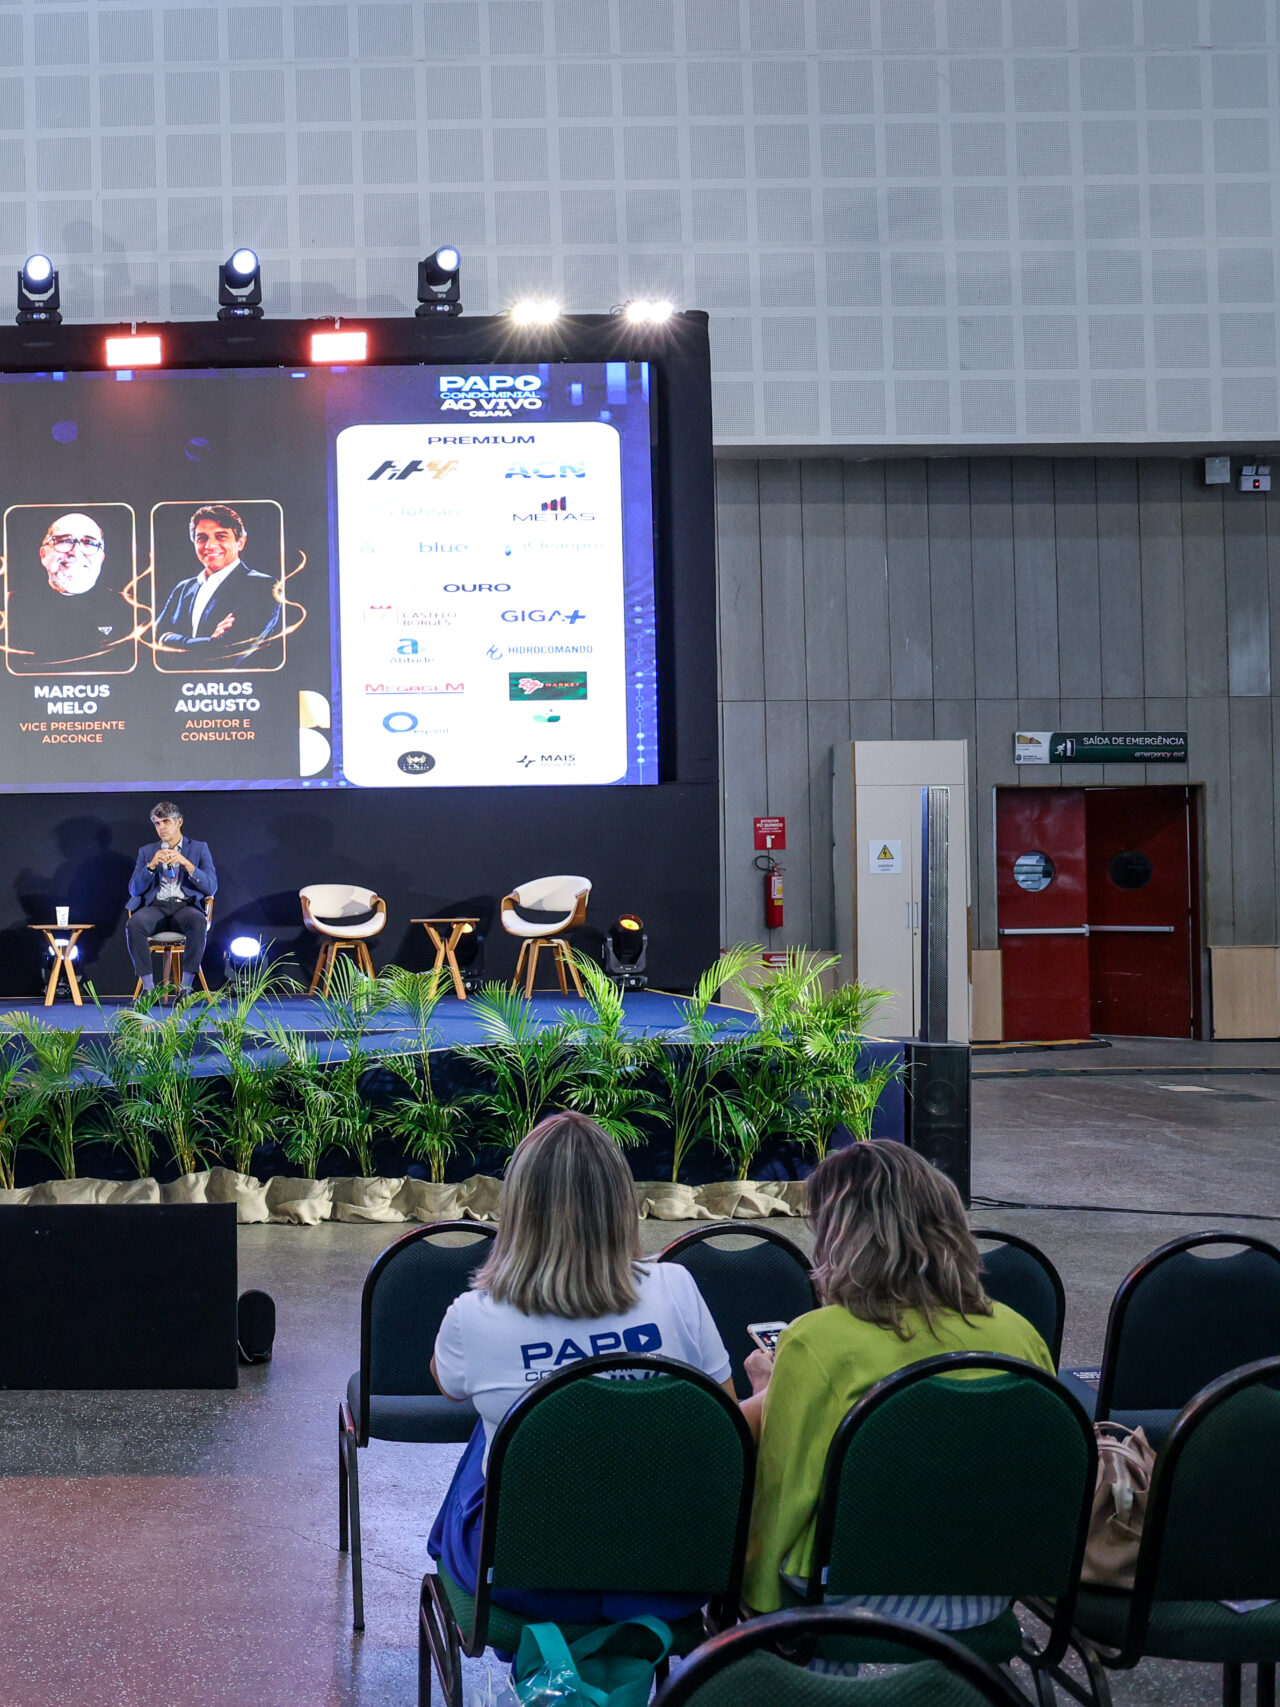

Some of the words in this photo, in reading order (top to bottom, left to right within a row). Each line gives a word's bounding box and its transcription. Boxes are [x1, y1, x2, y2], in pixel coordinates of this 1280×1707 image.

[439, 375, 542, 391] PAPO
[440, 399, 477, 410] AO
[479, 398, 543, 409] VIVO
[428, 435, 535, 445] PREMIUM
[513, 513, 595, 521] METAS
[443, 583, 511, 593] OURO
[508, 645, 593, 654] HIDROCOMANDO
[34, 684, 110, 699] MARCUS
[182, 682, 253, 696] CARLOS
[47, 701, 97, 715] MELO
[175, 698, 260, 713] AUGUSTO
[20, 722, 47, 732] VICE
[51, 720, 126, 731] PRESIDENTE
[185, 719, 240, 729] AUDITOR
[243, 719, 251, 728] E
[42, 733, 103, 744] ADCONCE
[181, 731, 255, 741] CONSULTOR
[1083, 735, 1111, 745] SAÍDA
[1112, 737, 1125, 745] DE
[1126, 735, 1185, 745] EMERGÊNCIA
